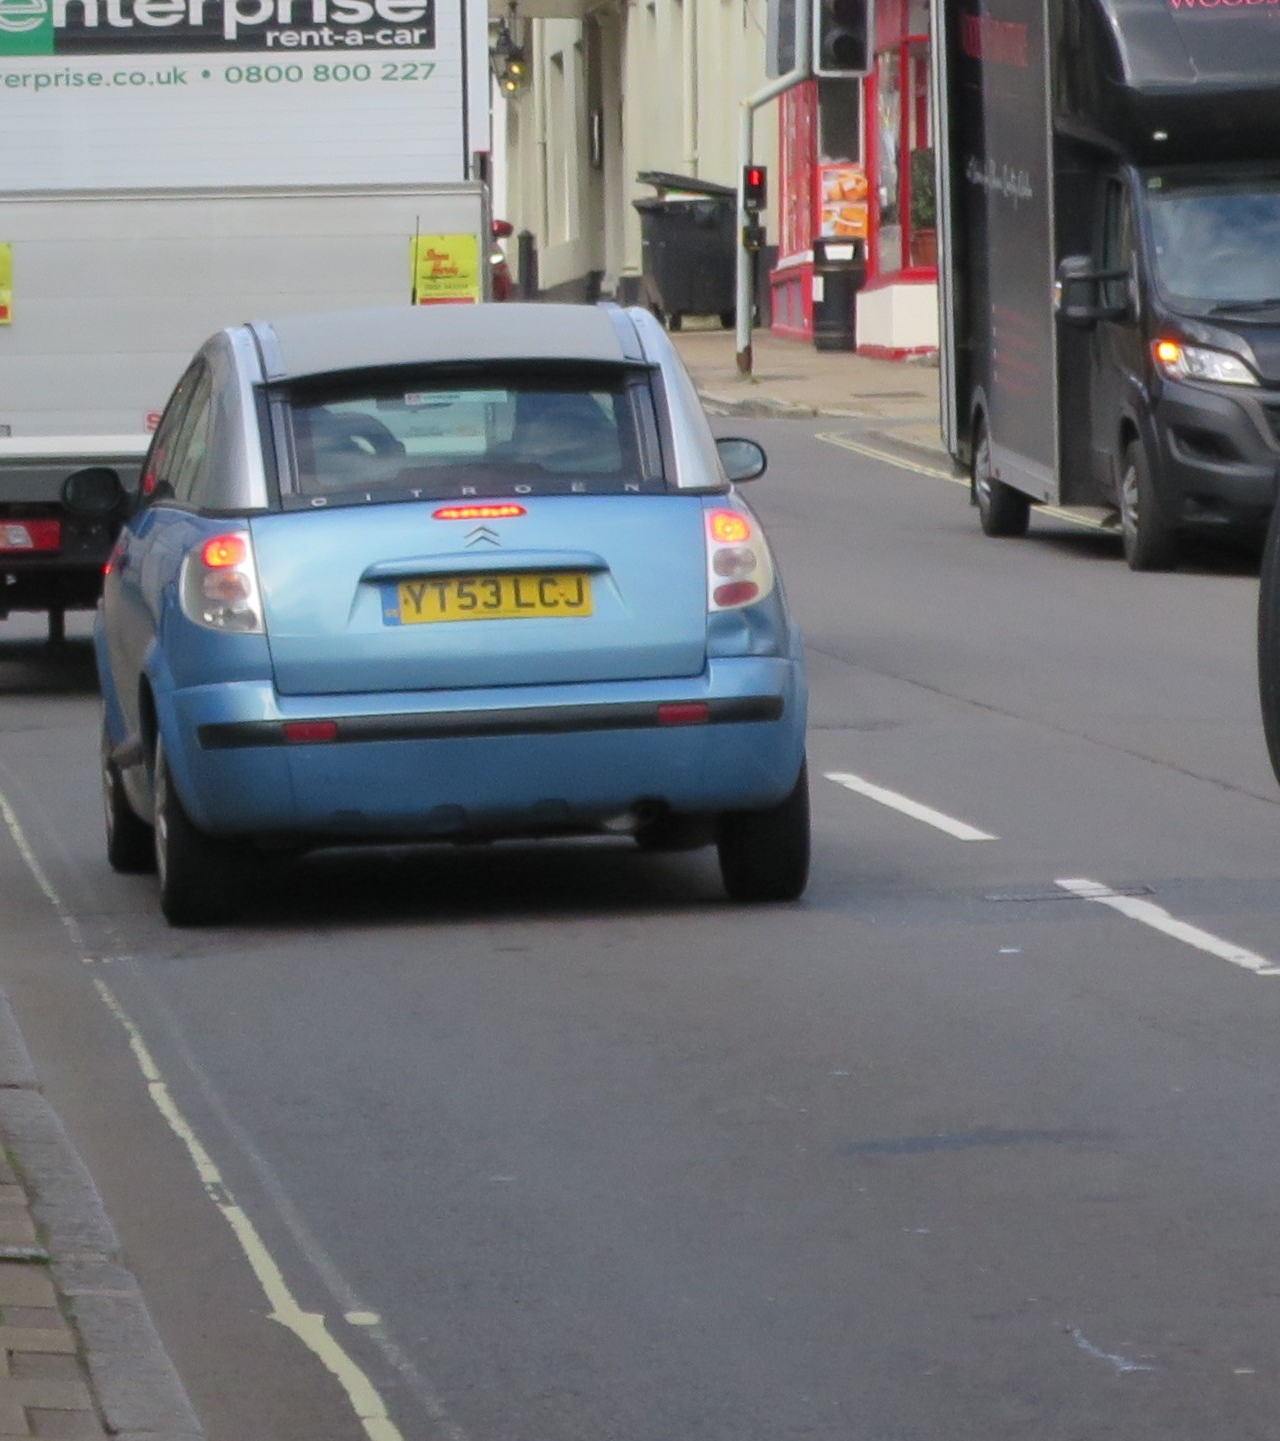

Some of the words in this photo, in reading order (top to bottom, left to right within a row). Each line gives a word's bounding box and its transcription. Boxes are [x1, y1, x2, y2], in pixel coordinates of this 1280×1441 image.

[266, 26, 427, 47] rent-a-car
[224, 65, 304, 84] 0800
[312, 63, 372, 82] 800
[380, 62, 437, 81] 227
[406, 578, 503, 614] YT53
[513, 577, 584, 609] LCJ
